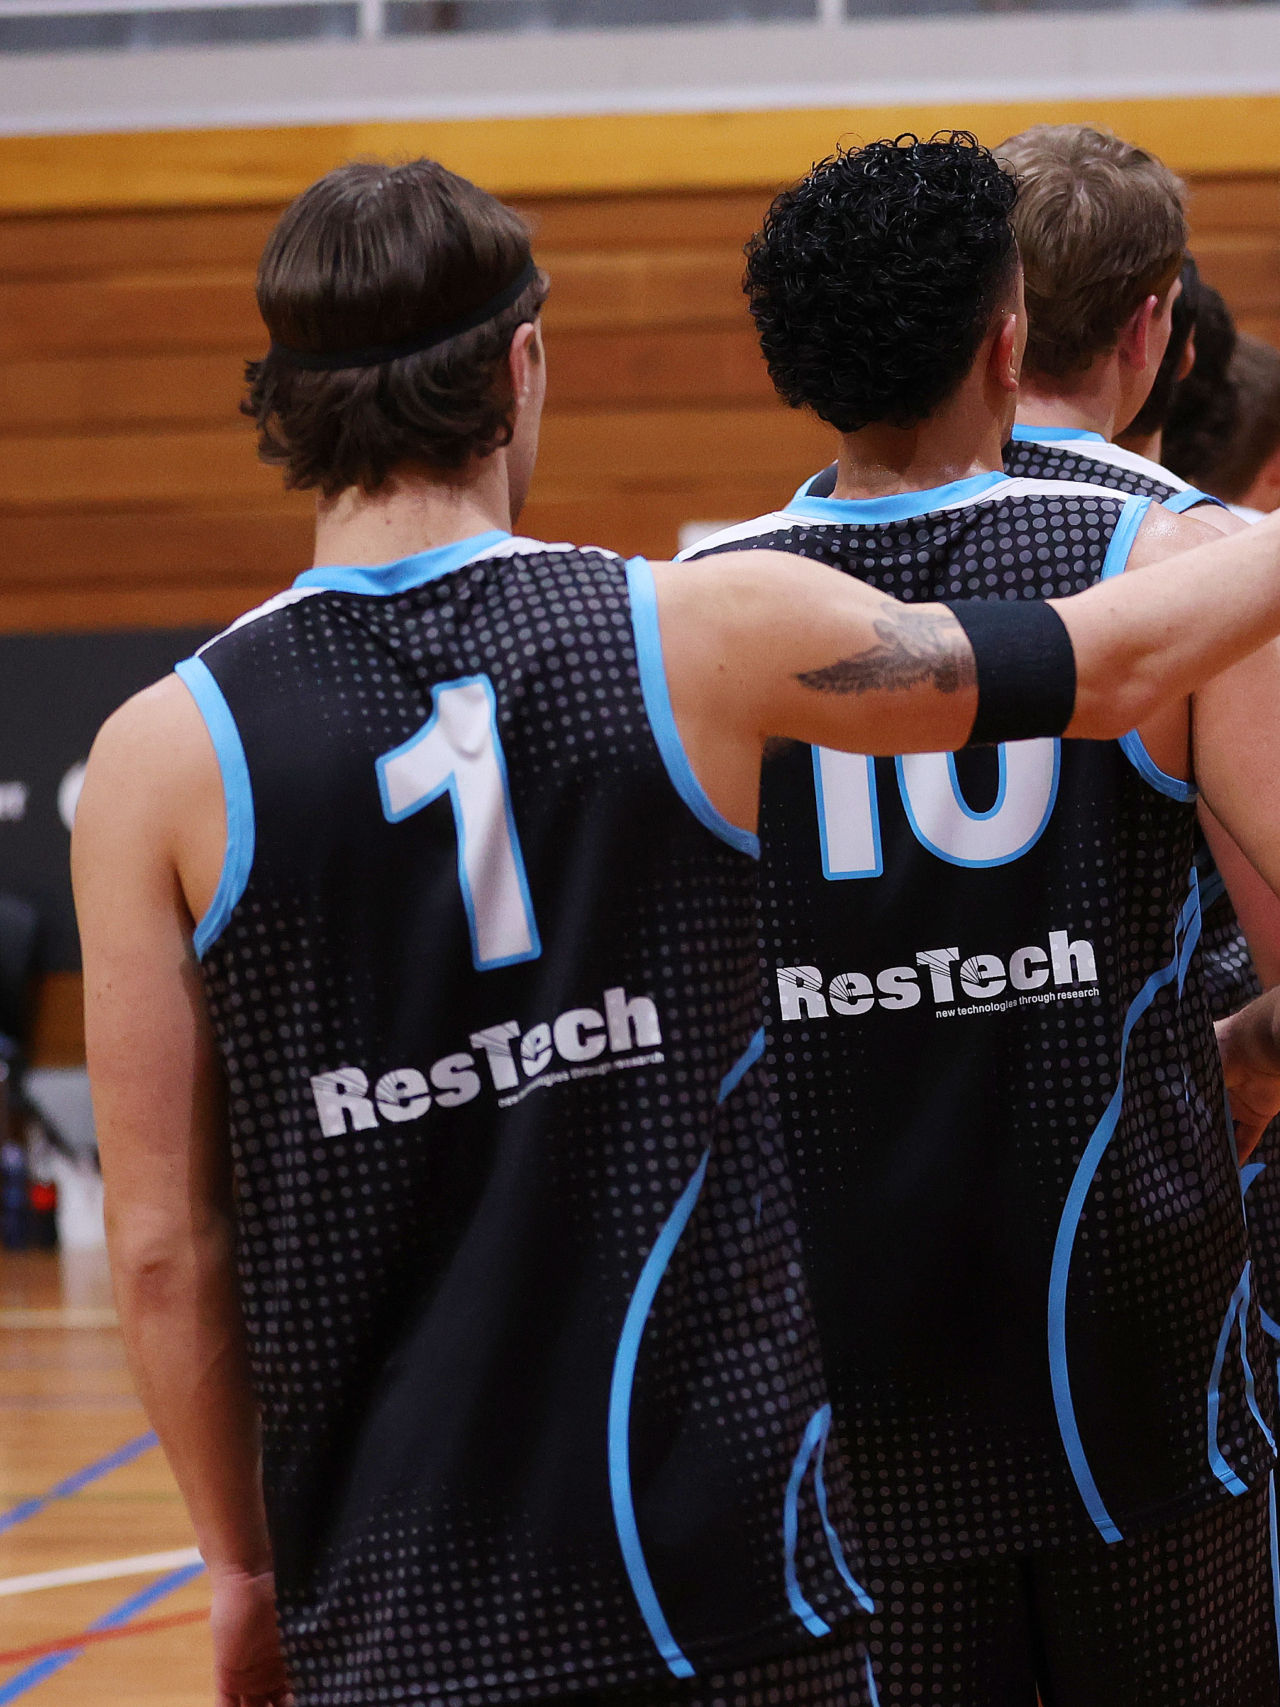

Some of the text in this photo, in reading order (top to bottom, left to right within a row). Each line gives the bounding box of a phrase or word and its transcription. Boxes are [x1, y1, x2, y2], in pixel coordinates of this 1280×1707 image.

[375, 672, 542, 972] 1
[776, 930, 1098, 1021] ResTech
[935, 987, 1100, 1019] new technologies through research
[311, 988, 662, 1137] ResTech
